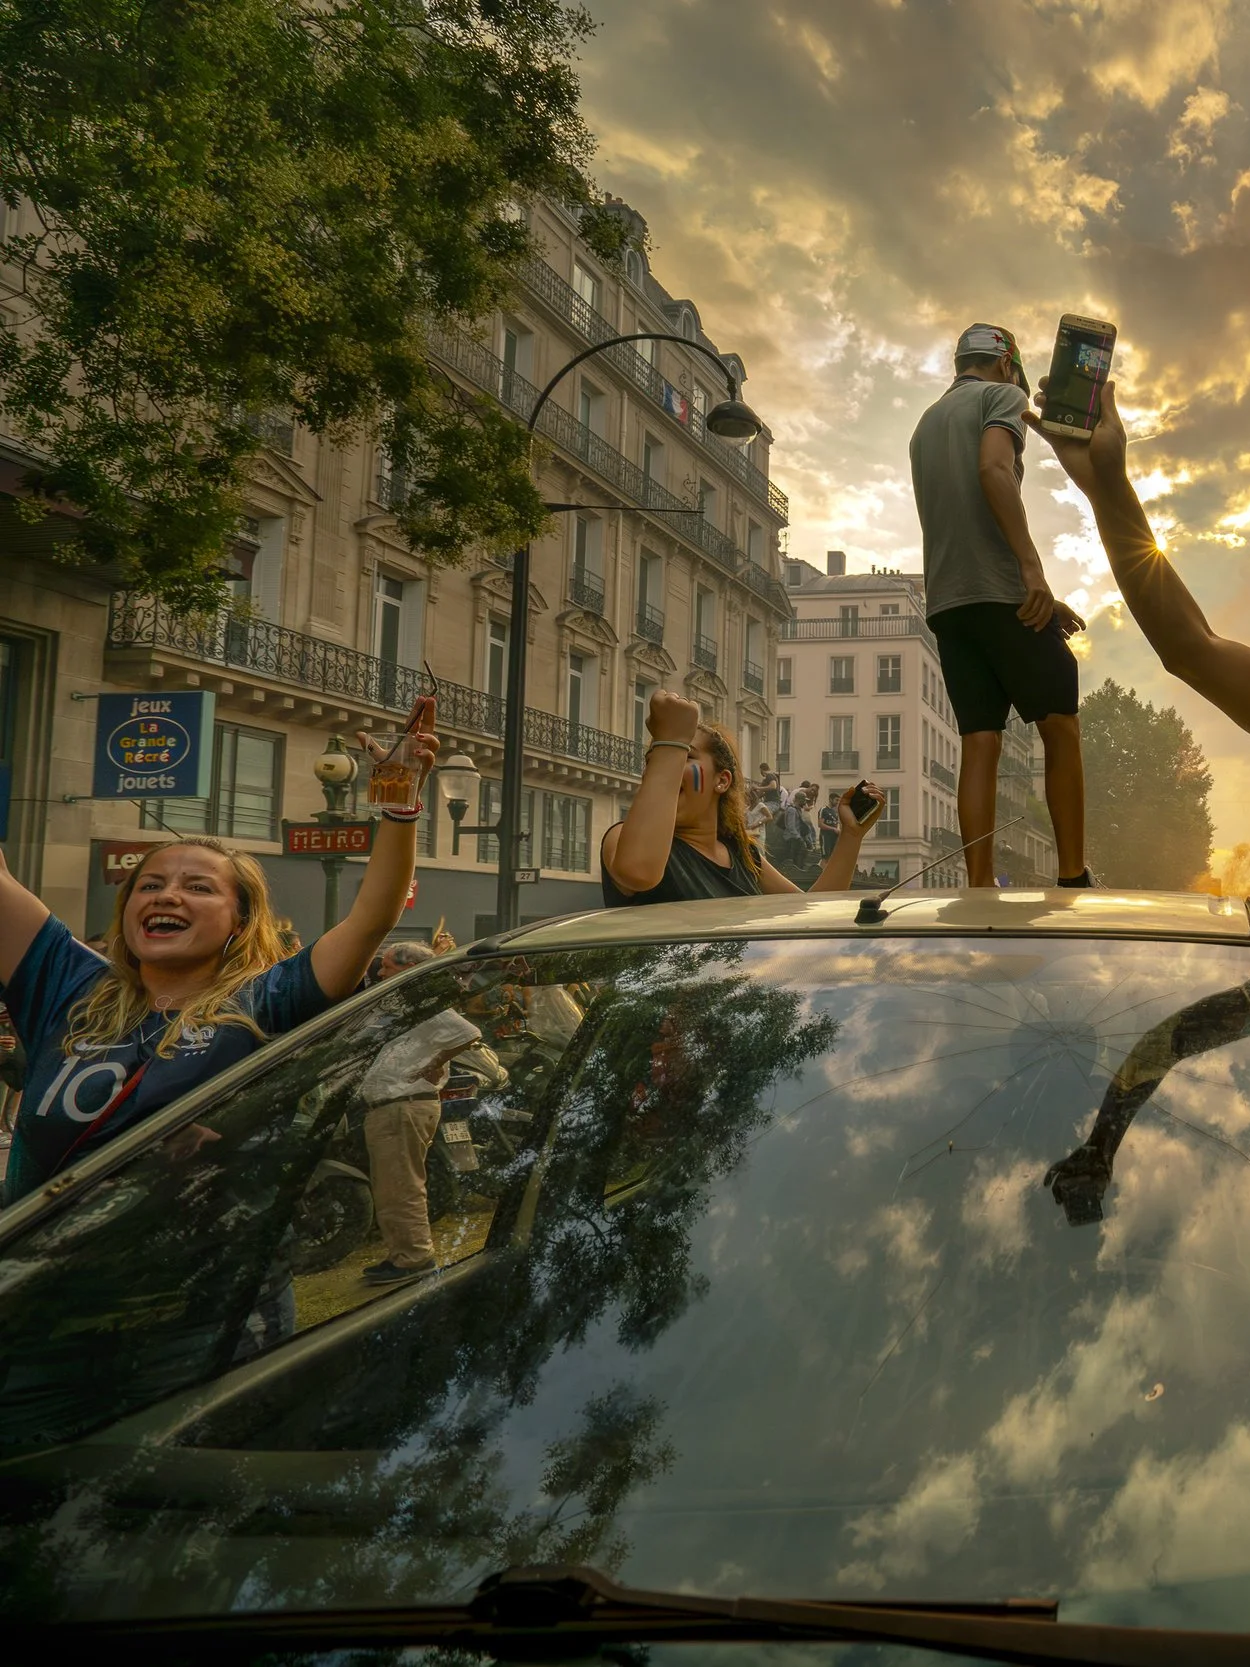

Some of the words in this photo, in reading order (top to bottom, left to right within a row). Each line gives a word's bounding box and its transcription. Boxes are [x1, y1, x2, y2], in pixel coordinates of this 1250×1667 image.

[130, 698, 172, 717] jeux
[140, 723, 158, 734] La
[120, 736, 176, 748] Grande
[124, 749, 171, 764] Récré
[116, 774, 175, 793] jouets
[294, 830, 365, 850] METRO
[520, 872, 531, 880] 27
[35, 1055, 127, 1123] 10
